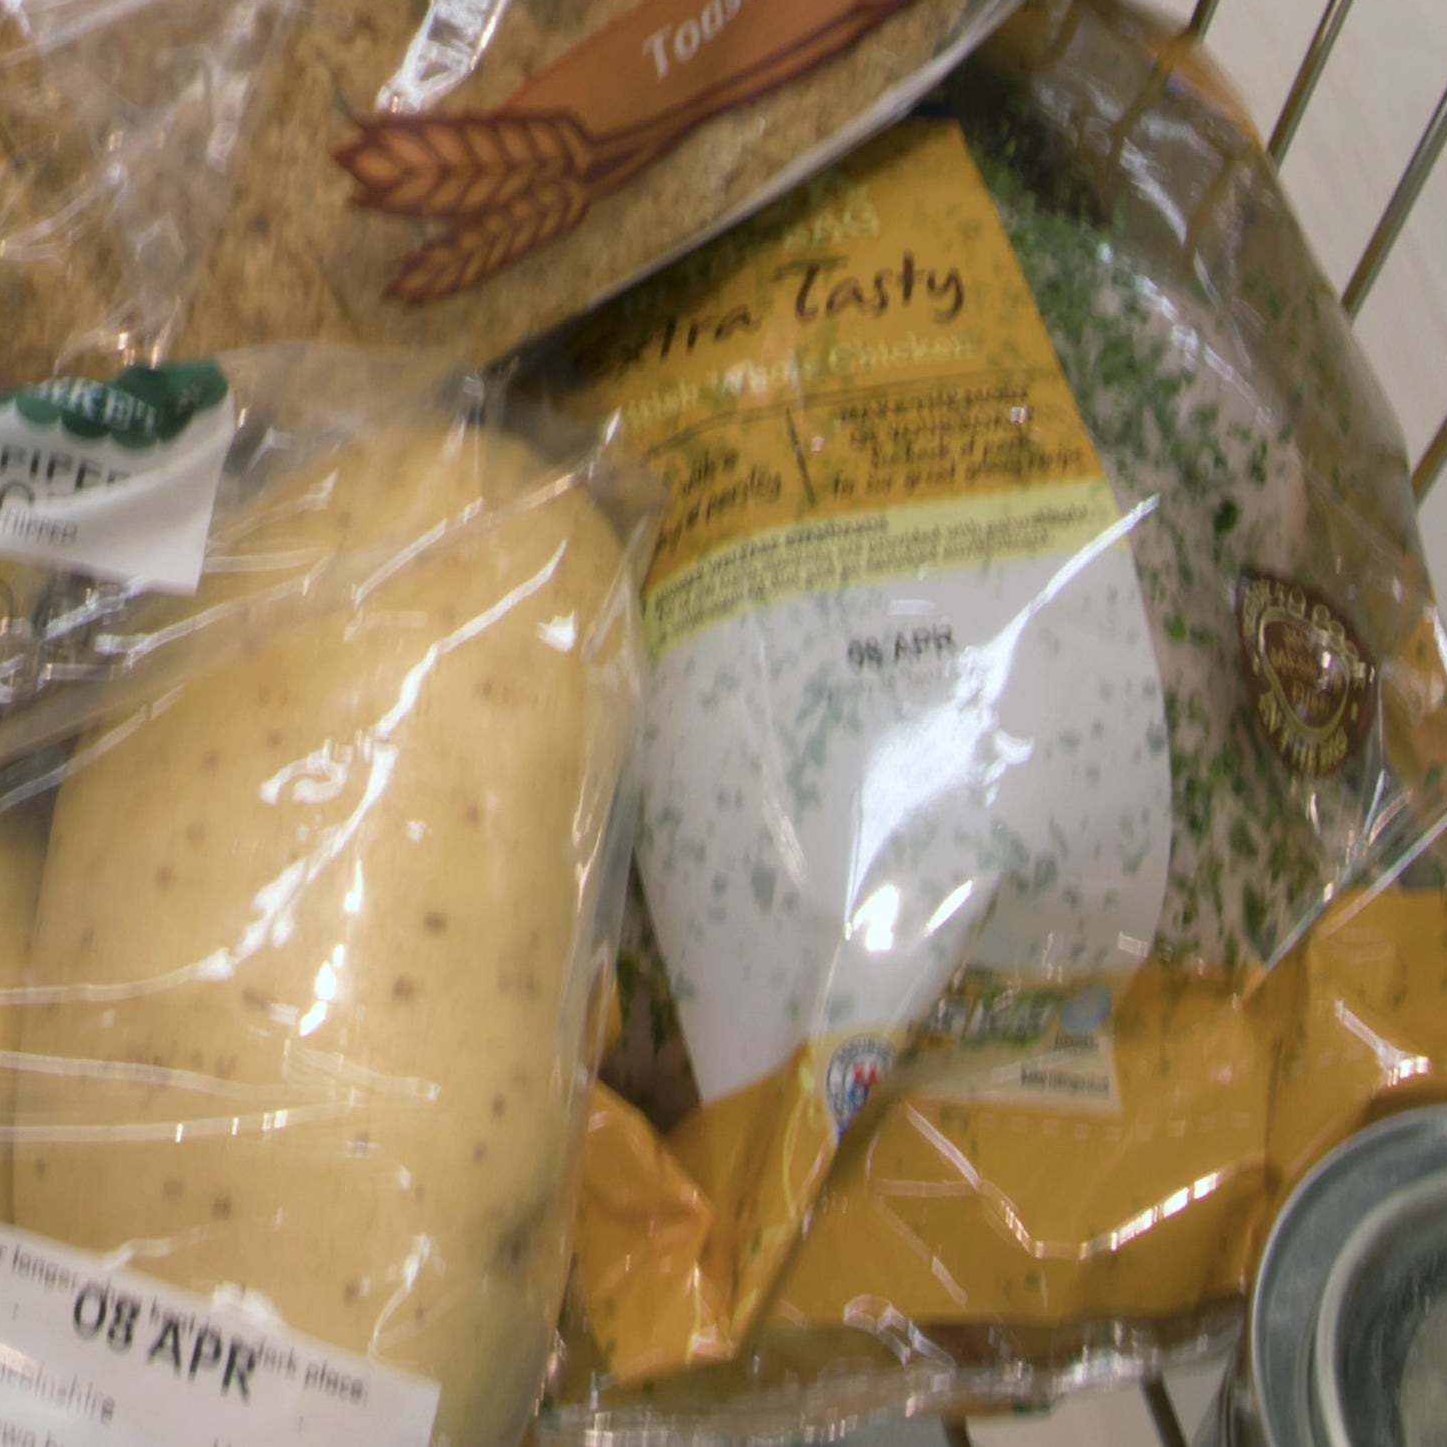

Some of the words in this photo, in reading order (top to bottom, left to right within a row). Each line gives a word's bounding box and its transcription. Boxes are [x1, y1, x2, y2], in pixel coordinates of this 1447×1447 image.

[776, 250, 966, 325] Tasty
[10, 1244, 80, 1296] longer
[73, 1279, 142, 1354] 08
[145, 1311, 257, 1408] APR
